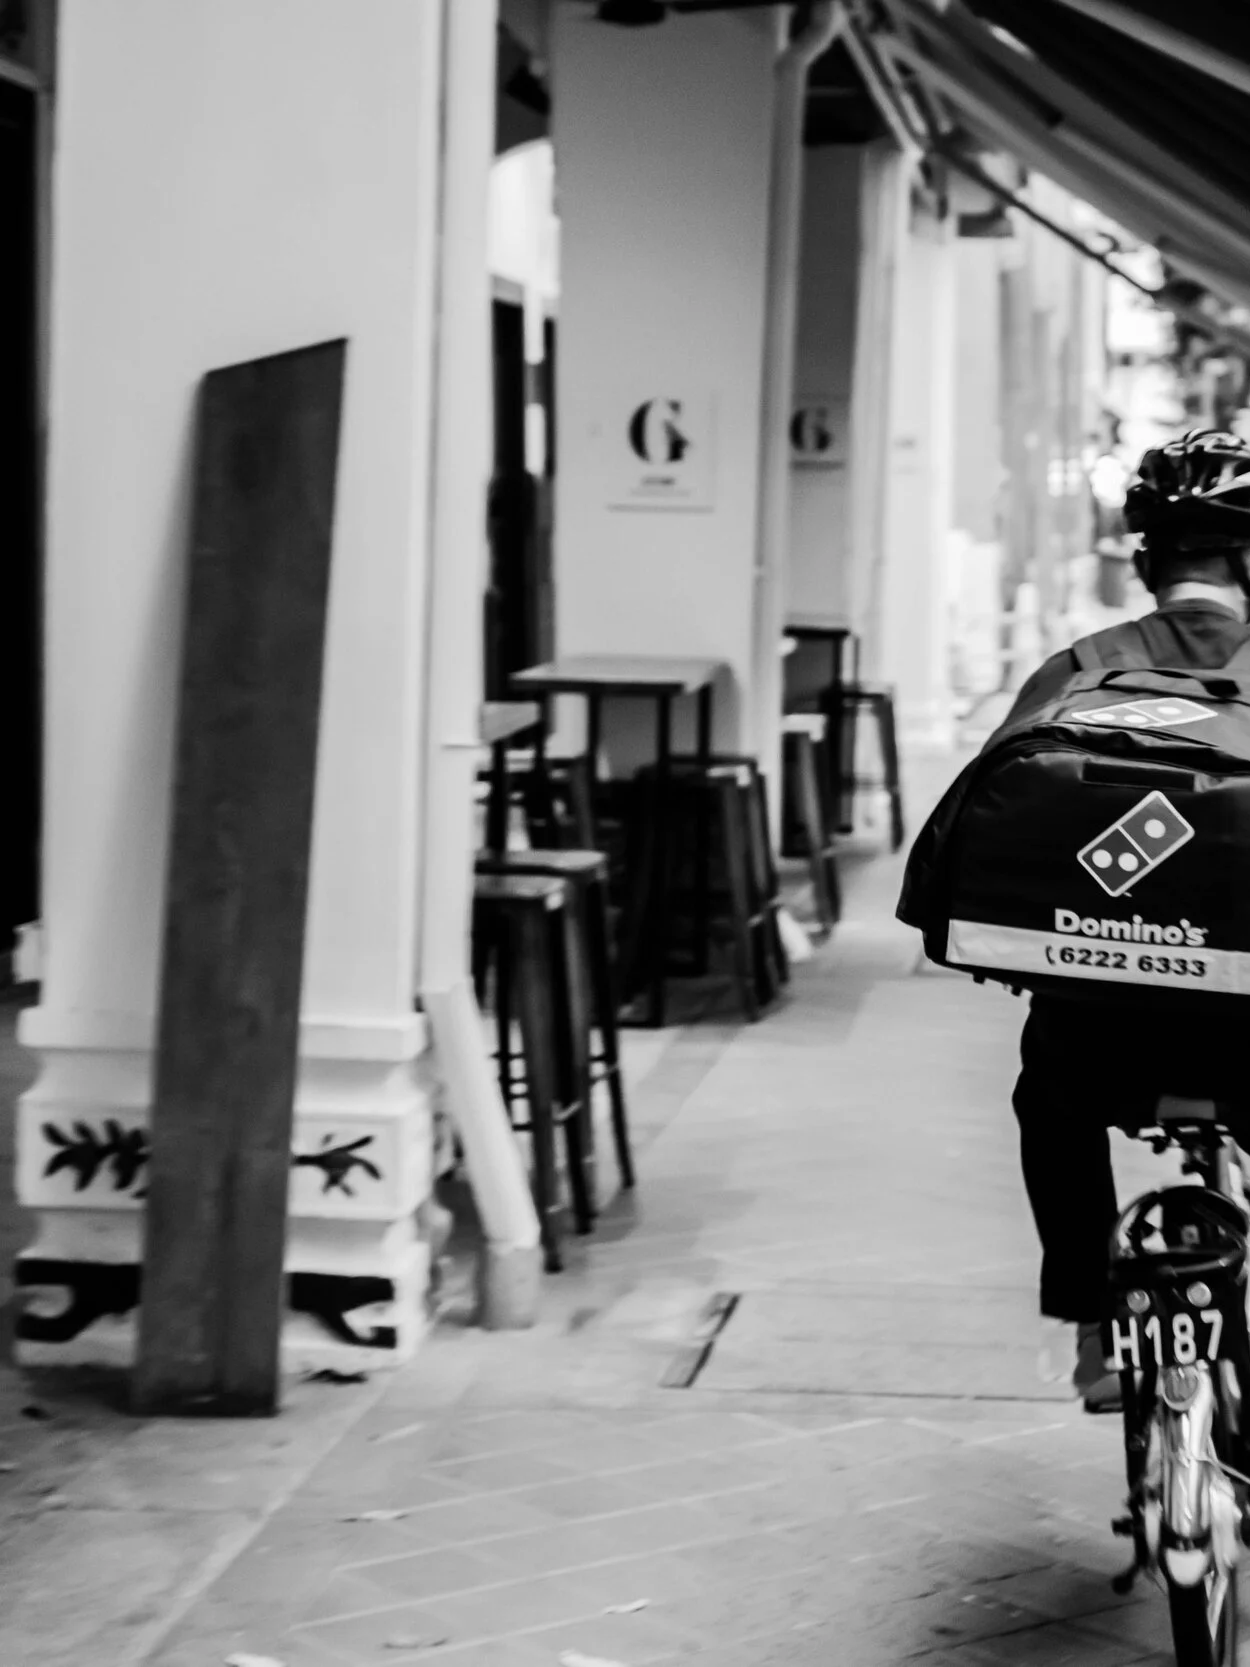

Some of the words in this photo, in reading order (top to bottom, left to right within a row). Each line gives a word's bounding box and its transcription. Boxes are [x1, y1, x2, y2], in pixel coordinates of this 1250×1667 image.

[628, 399, 689, 463] G
[1054, 907, 1206, 947] Domino's
[1059, 946, 1128, 970] 6222
[1137, 954, 1207, 978] 6333
[1111, 1308, 1223, 1369] H187
